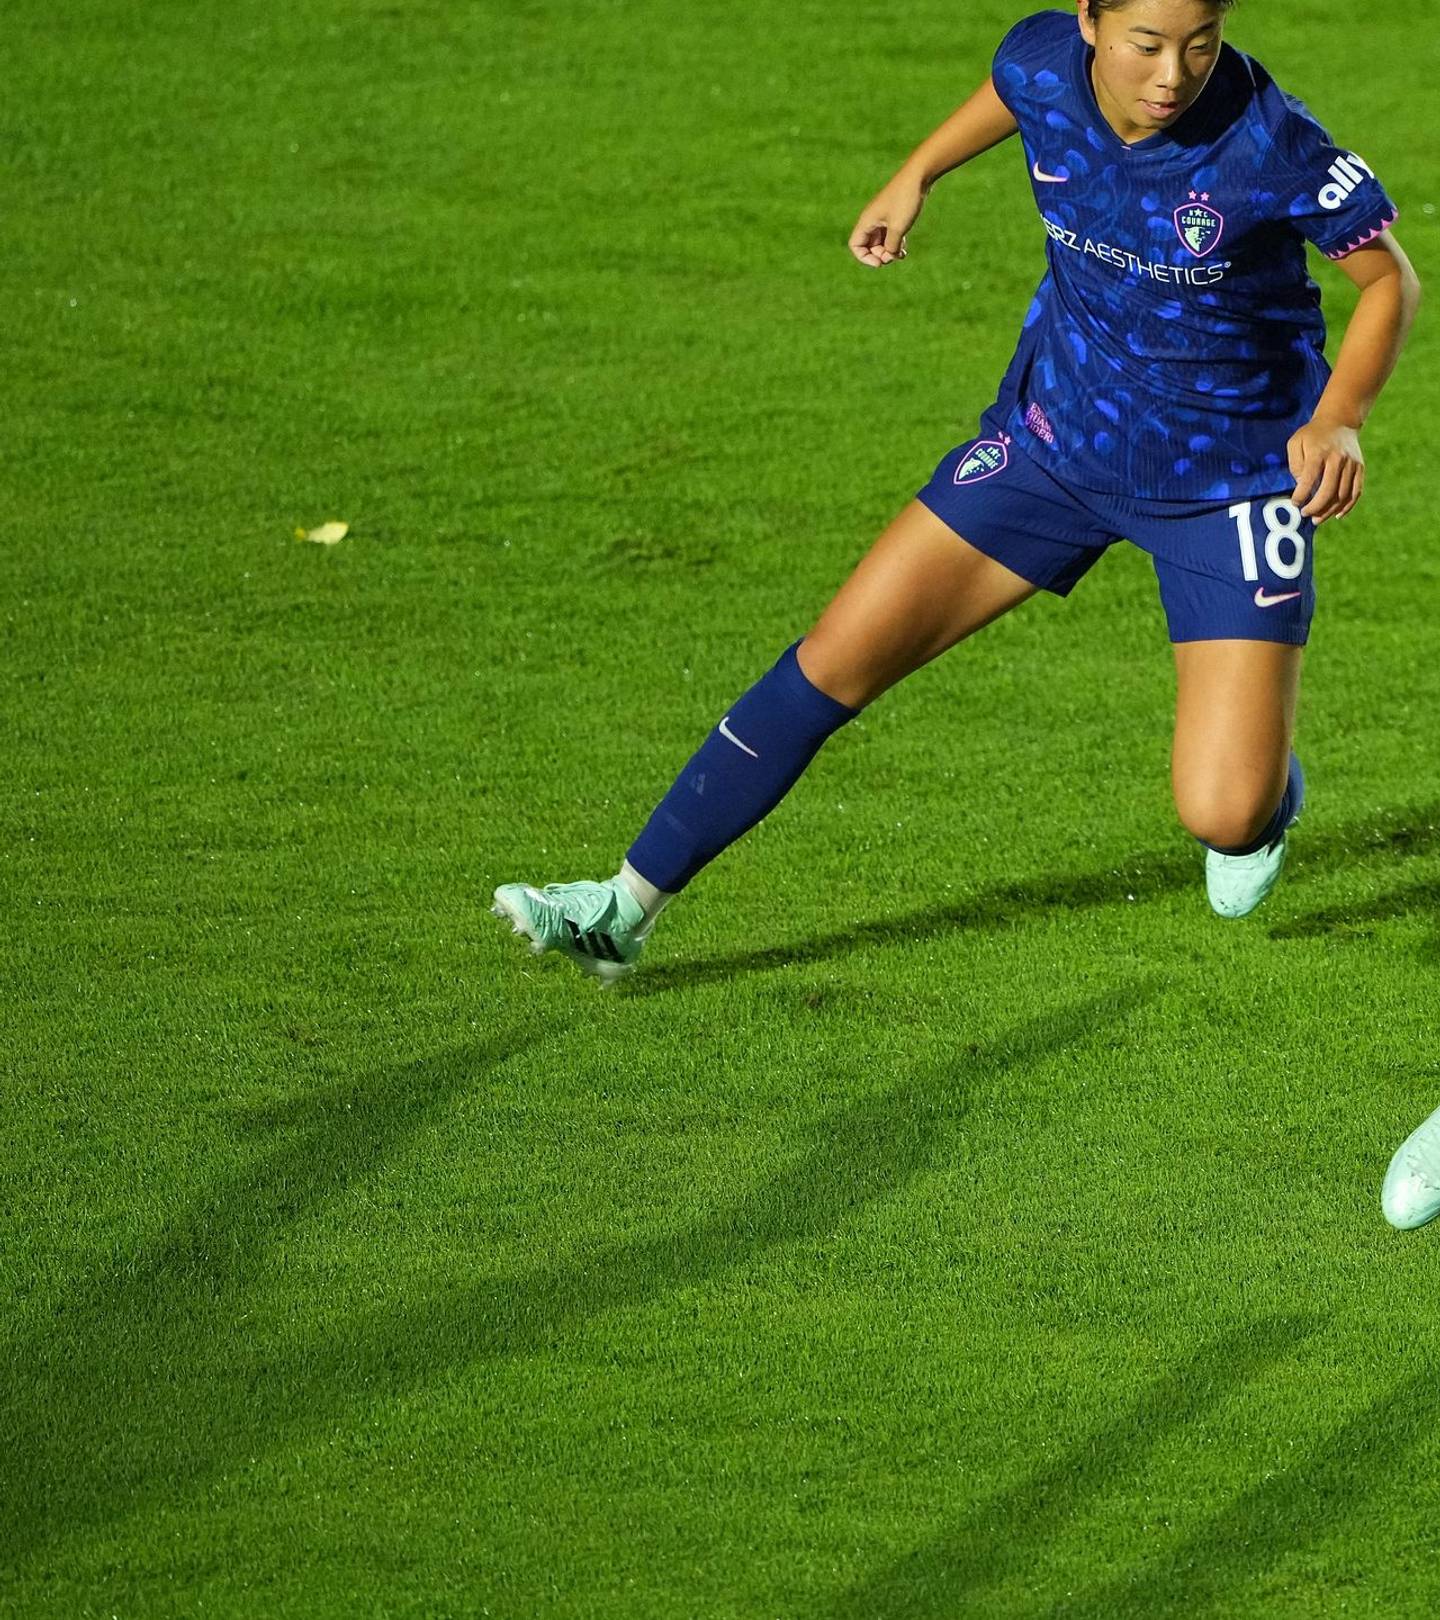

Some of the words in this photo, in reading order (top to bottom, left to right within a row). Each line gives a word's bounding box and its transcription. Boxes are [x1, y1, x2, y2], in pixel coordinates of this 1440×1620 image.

[1318, 151, 1375, 210] ally
[1040, 213, 1081, 250] ERZ
[1181, 216, 1216, 227] COURAGE
[1228, 498, 1306, 581] 18
